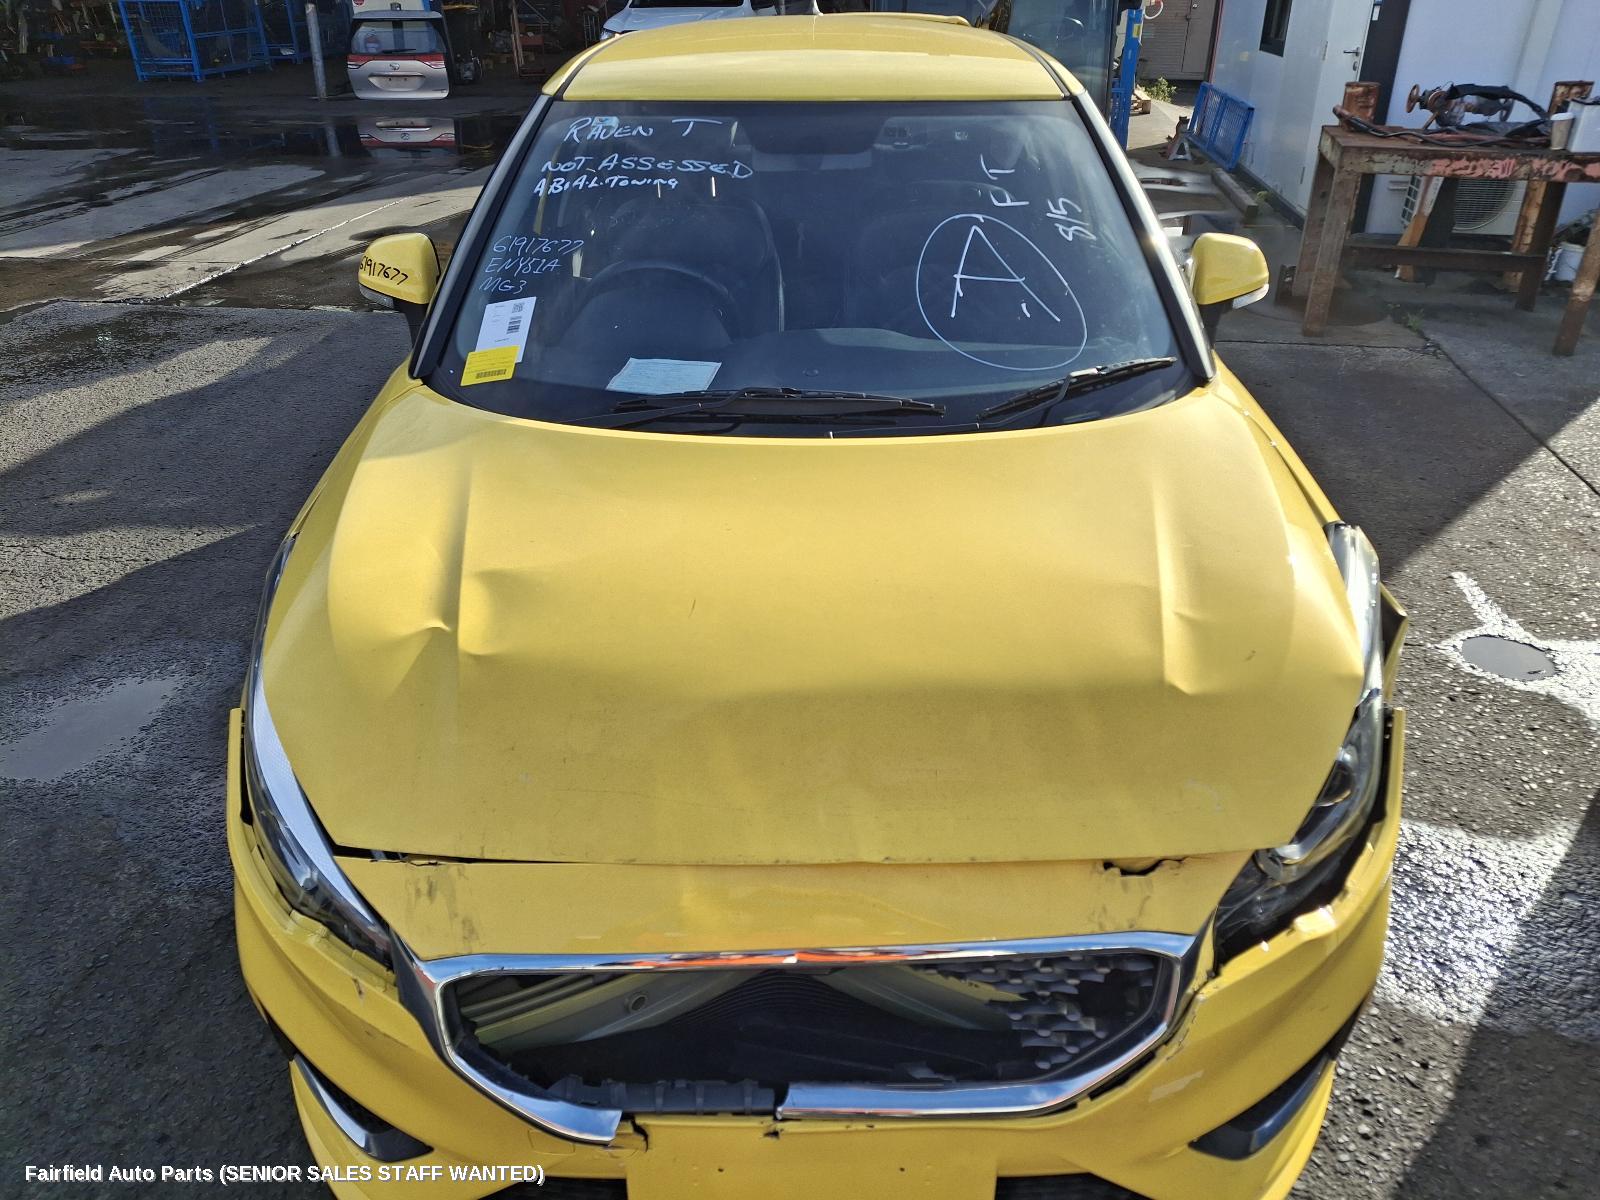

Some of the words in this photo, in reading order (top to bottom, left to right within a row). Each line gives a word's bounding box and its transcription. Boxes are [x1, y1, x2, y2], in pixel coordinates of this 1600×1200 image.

[541, 156, 595, 173] NOT
[598, 153, 753, 180] ASSESSED
[493, 235, 584, 256] 61917677
[360, 255, 409, 285] 61917677
